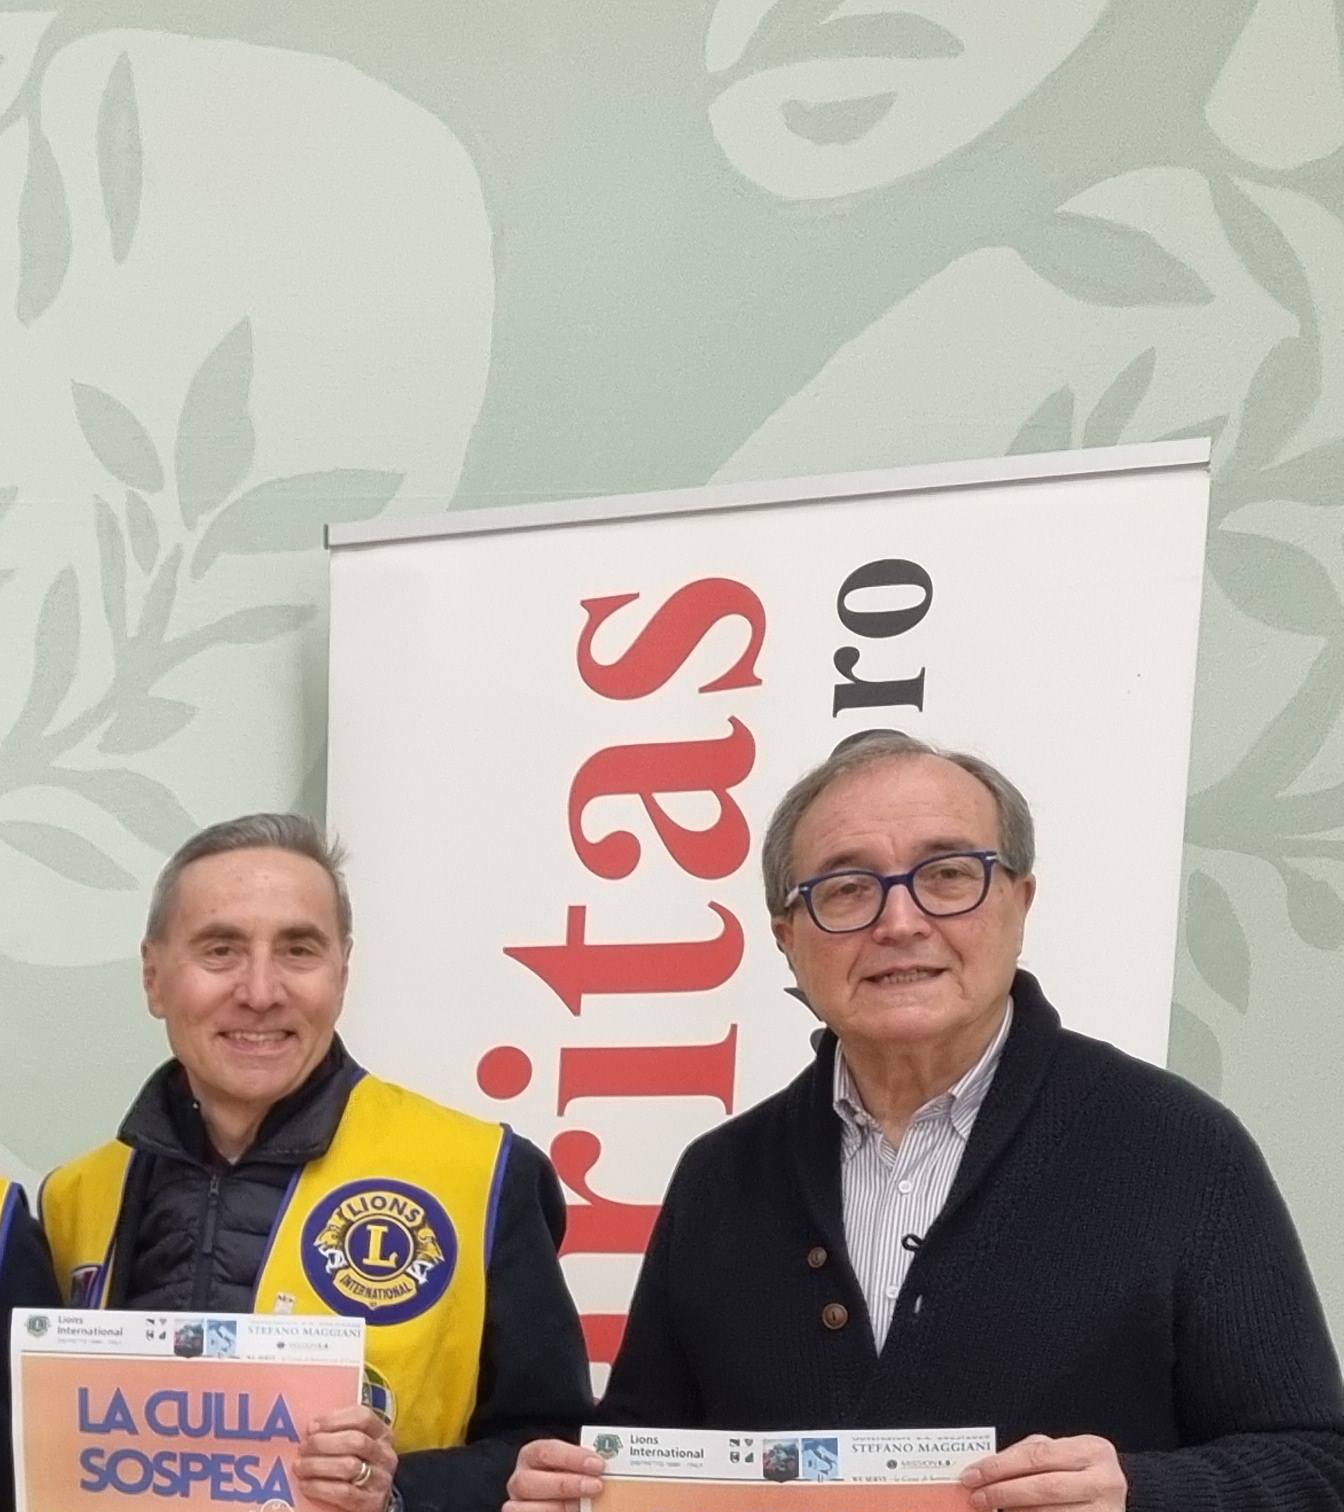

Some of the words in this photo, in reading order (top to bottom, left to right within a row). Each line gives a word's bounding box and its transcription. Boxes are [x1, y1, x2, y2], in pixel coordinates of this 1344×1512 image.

[476, 577, 767, 1400] ritas
[350, 1195, 421, 1223] LIONS
[362, 1224, 398, 1268] L
[341, 1274, 413, 1299] INTERNATIONAL
[57, 1316, 83, 1325] Lions
[57, 1326, 124, 1337] International
[248, 1325, 299, 1335] STEFANO
[302, 1326, 361, 1337] MAGGIANI
[78, 1386, 139, 1437] LA
[144, 1388, 301, 1443] CULLA
[630, 1434, 658, 1444] Lions
[852, 1443, 914, 1453] STEFANO
[919, 1441, 991, 1453] MAGGIANI
[629, 1446, 704, 1458] International
[79, 1447, 295, 1507] SOSPESA
